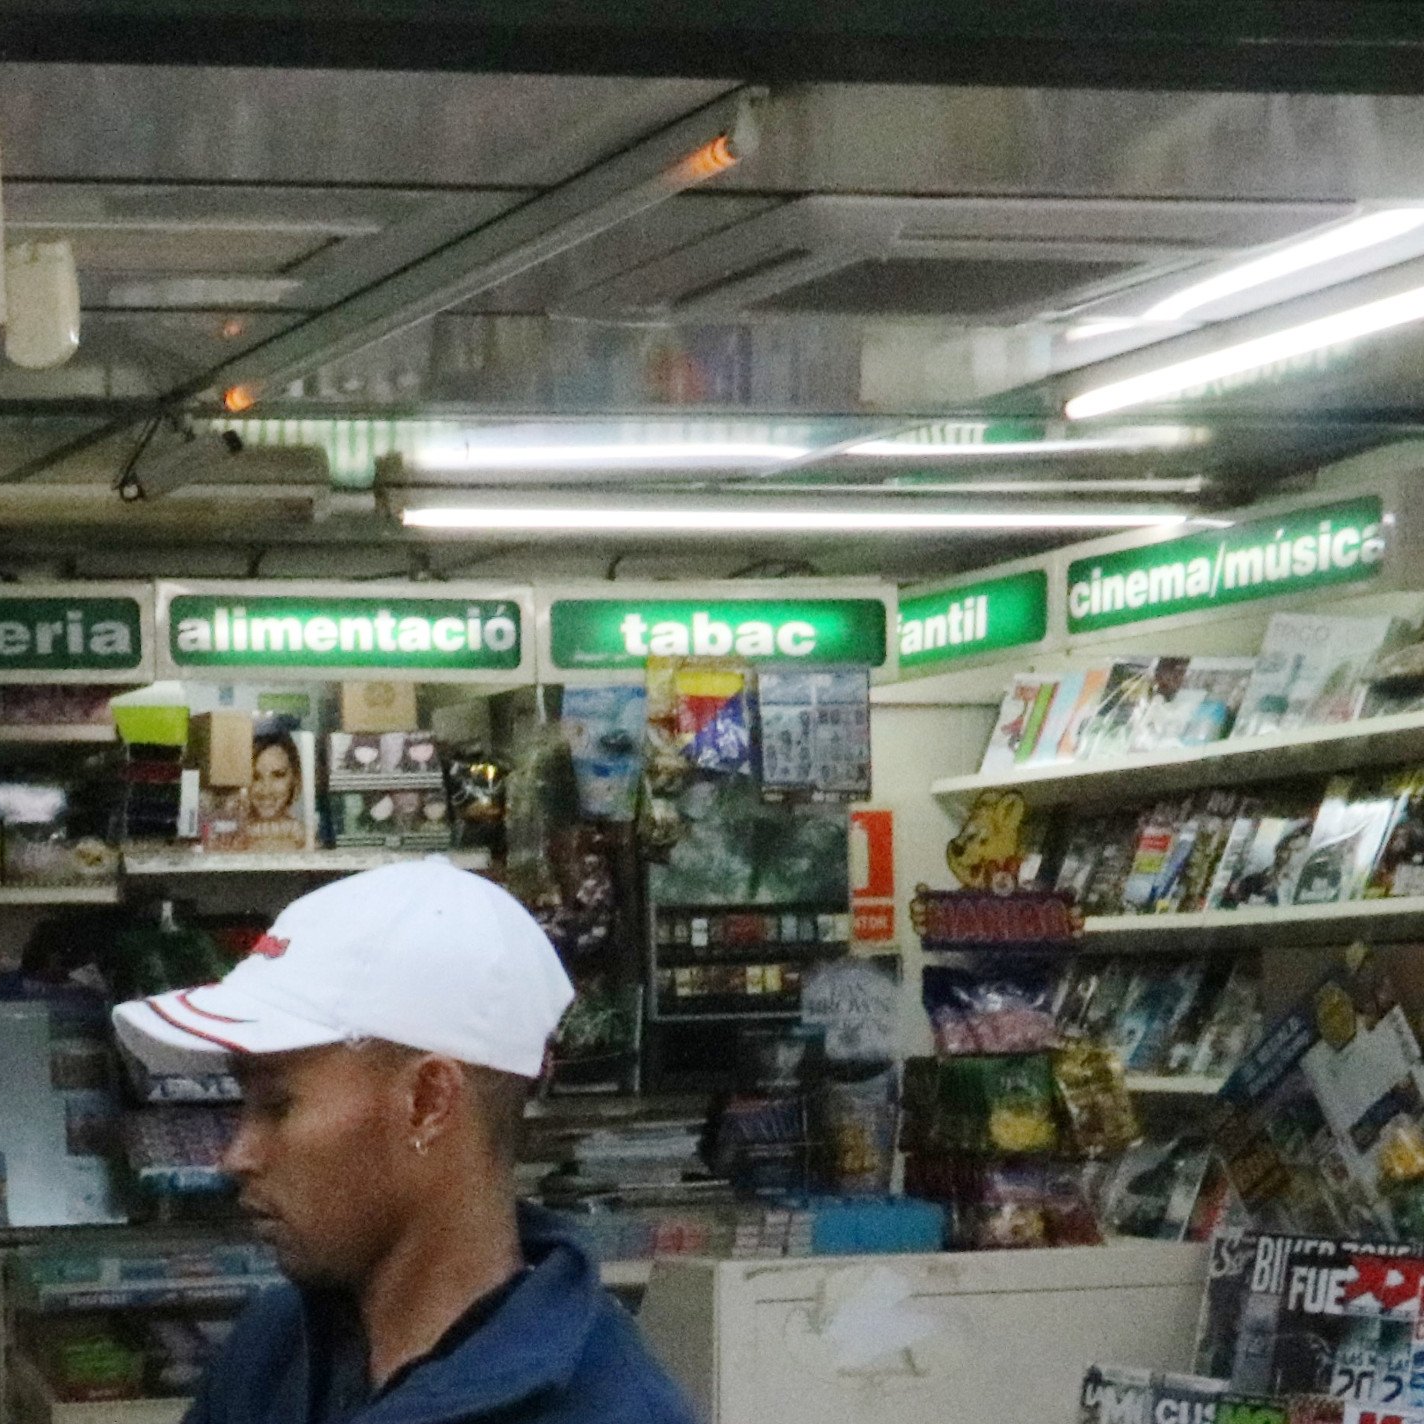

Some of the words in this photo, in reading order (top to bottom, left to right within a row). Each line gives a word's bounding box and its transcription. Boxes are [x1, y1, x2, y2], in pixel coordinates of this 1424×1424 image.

[1069, 518, 1385, 619] cinema/música
[177, 600, 517, 655] alimentació
[619, 612, 819, 658] tabac
[893, 594, 989, 656] antil
